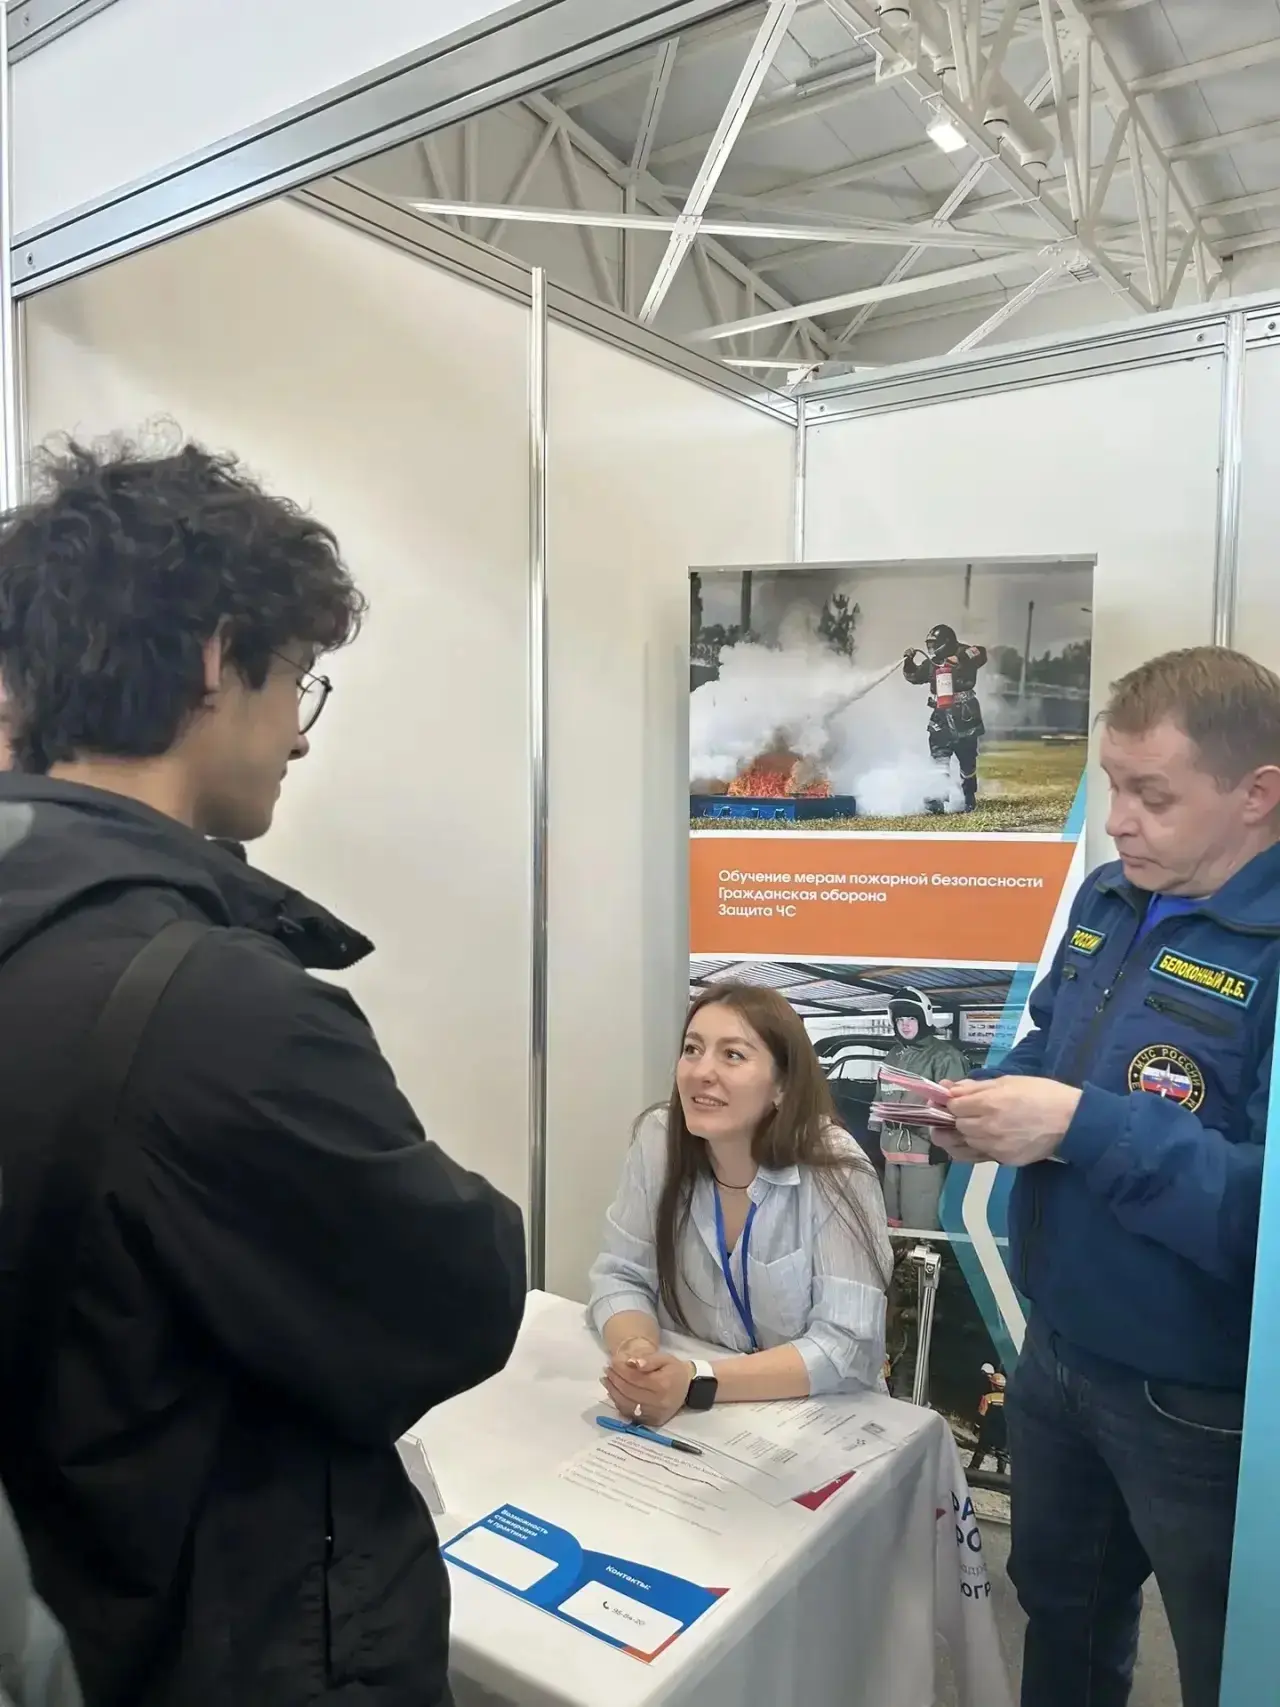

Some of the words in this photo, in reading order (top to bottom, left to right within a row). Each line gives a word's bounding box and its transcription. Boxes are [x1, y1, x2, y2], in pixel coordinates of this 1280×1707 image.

[718, 870, 791, 885] Обучение
[794, 874, 846, 886] мерам
[849, 873, 928, 887] пожарной
[931, 873, 1043, 888] безопасности
[718, 887, 817, 901] Гражданская
[820, 889, 887, 903] оборона
[718, 904, 773, 918] Защита
[776, 904, 797, 917] ЧС
[1159, 954, 1225, 989] БЕЛОКОННЫЙ
[1220, 977, 1246, 999] Д.Б.
[1134, 1049, 1157, 1070] МЧС
[1162, 1048, 1201, 1086] РОССИИ
[494, 1514, 538, 1537] стажировки
[500, 1509, 549, 1534] Возможность
[605, 1564, 652, 1590] Контакты:
